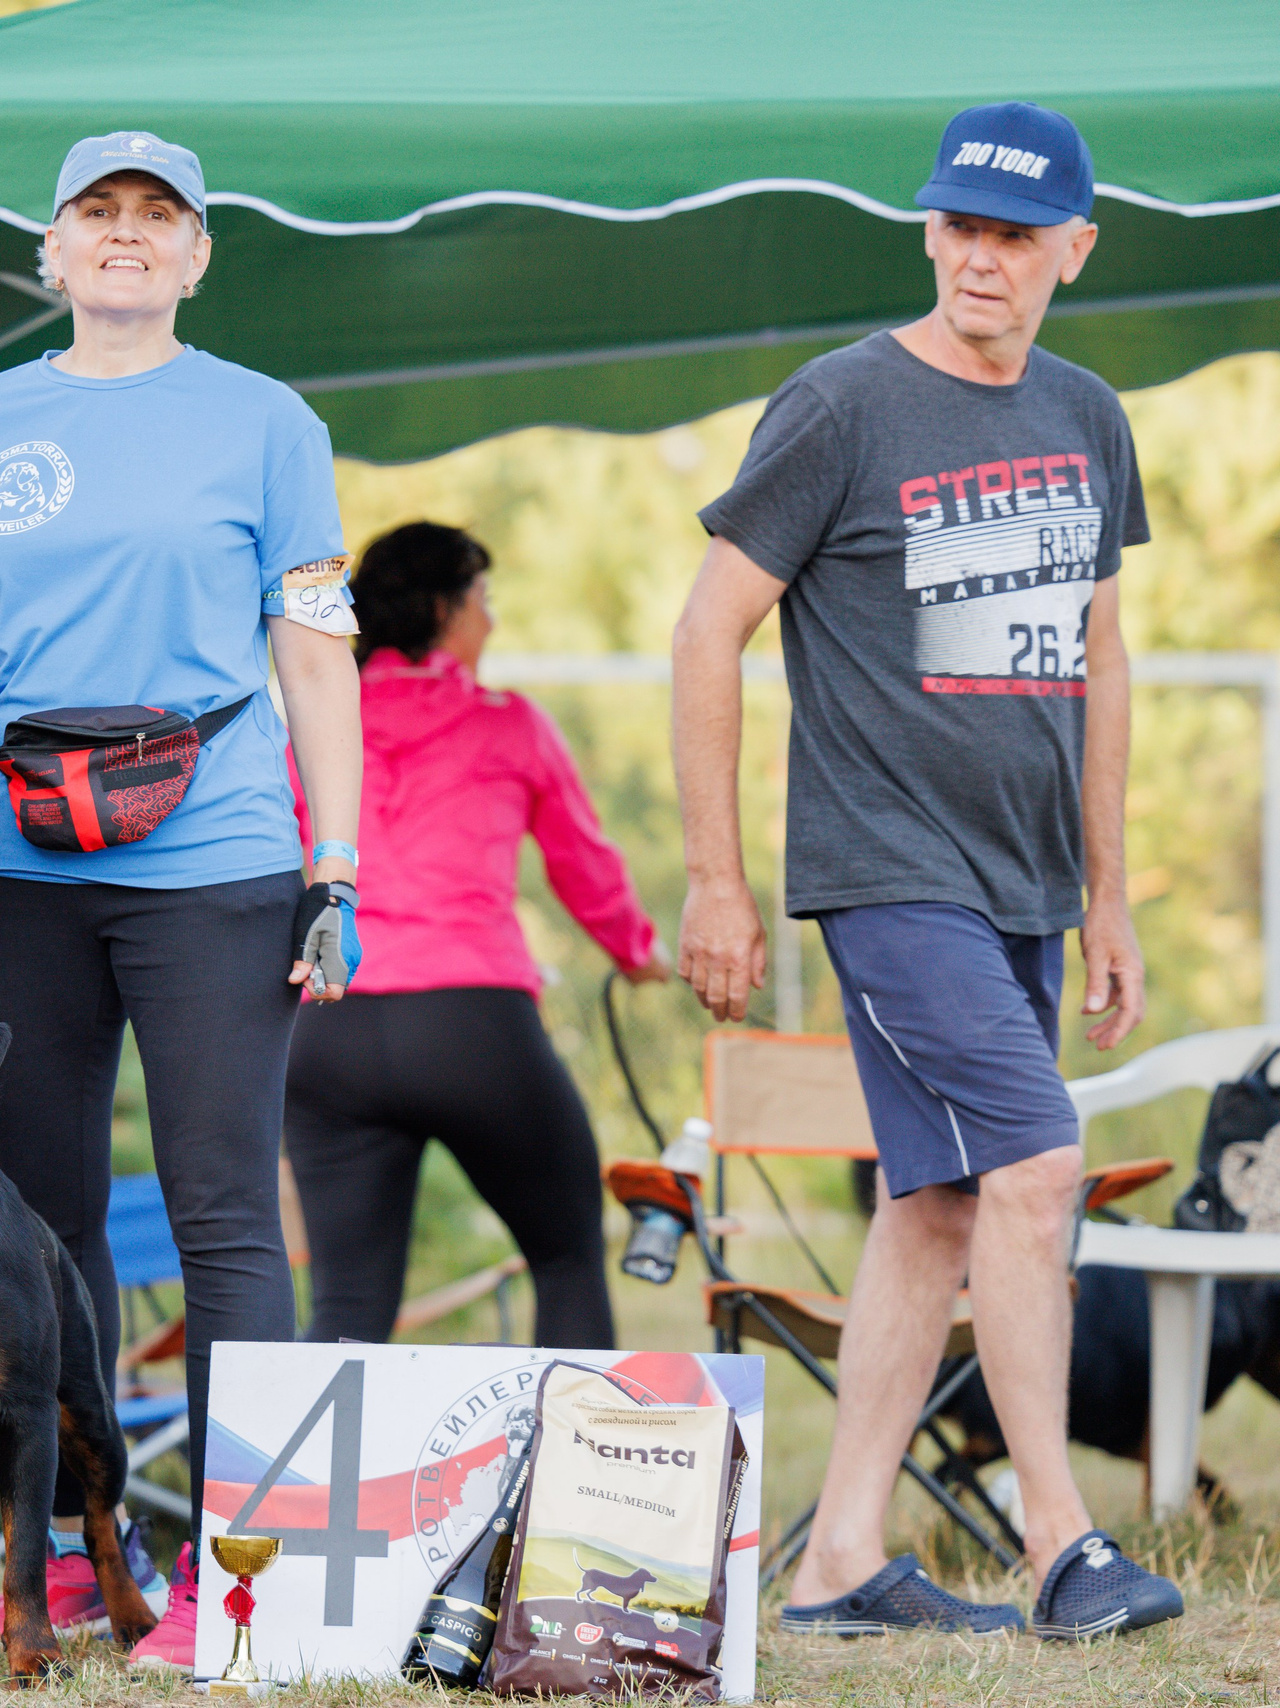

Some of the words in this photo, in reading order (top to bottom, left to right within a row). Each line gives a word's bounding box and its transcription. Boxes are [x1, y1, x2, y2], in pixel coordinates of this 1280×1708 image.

[952, 142, 995, 166] ZOO
[990, 145, 1050, 179] YORK
[32, 443, 68, 471] TORRA
[899, 453, 1094, 535] STREET
[593, 1416, 640, 1425] говядиной
[648, 1418, 677, 1426] рисом
[606, 1461, 656, 1475] premium
[227, 1360, 389, 1627] 4
[577, 1485, 676, 1518] SMALL/MEDIUM
[430, 1615, 482, 1642] CASPICO
